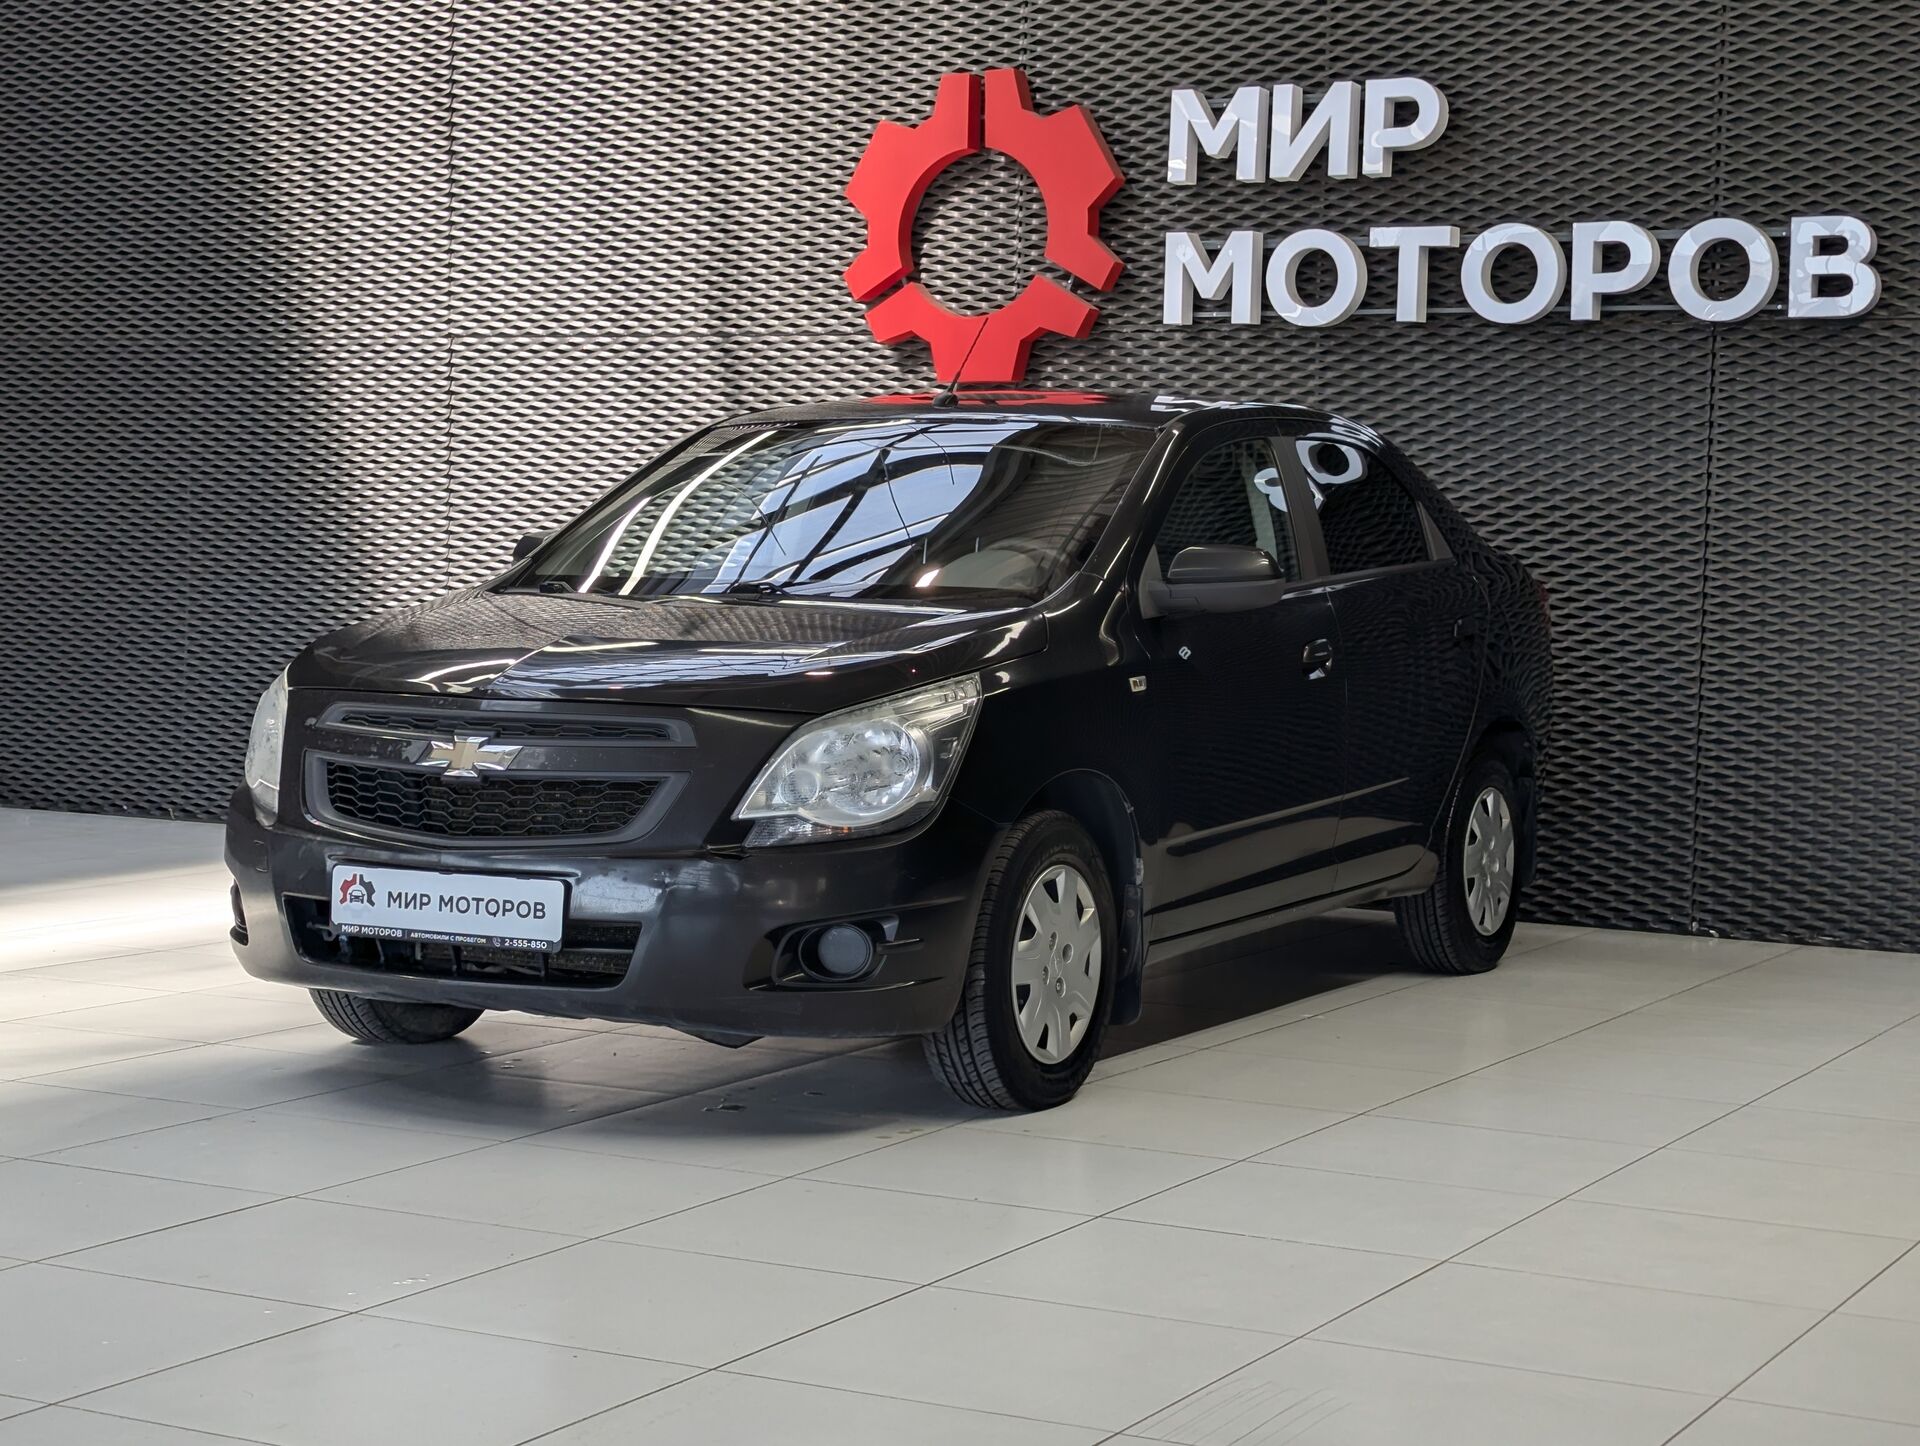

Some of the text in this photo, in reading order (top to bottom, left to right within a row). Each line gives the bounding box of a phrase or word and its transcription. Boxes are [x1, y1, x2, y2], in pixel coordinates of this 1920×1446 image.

[1167, 76, 1449, 186] МИР
[1163, 215, 1881, 326] МОТОРОВ
[387, 890, 546, 920] МИР МОТОРОВ
[341, 924, 403, 938] МИР МОТОРОВ
[410, 932, 450, 941] АВТОМОБИЛИ
[504, 938, 548, 949] 2-555-850
